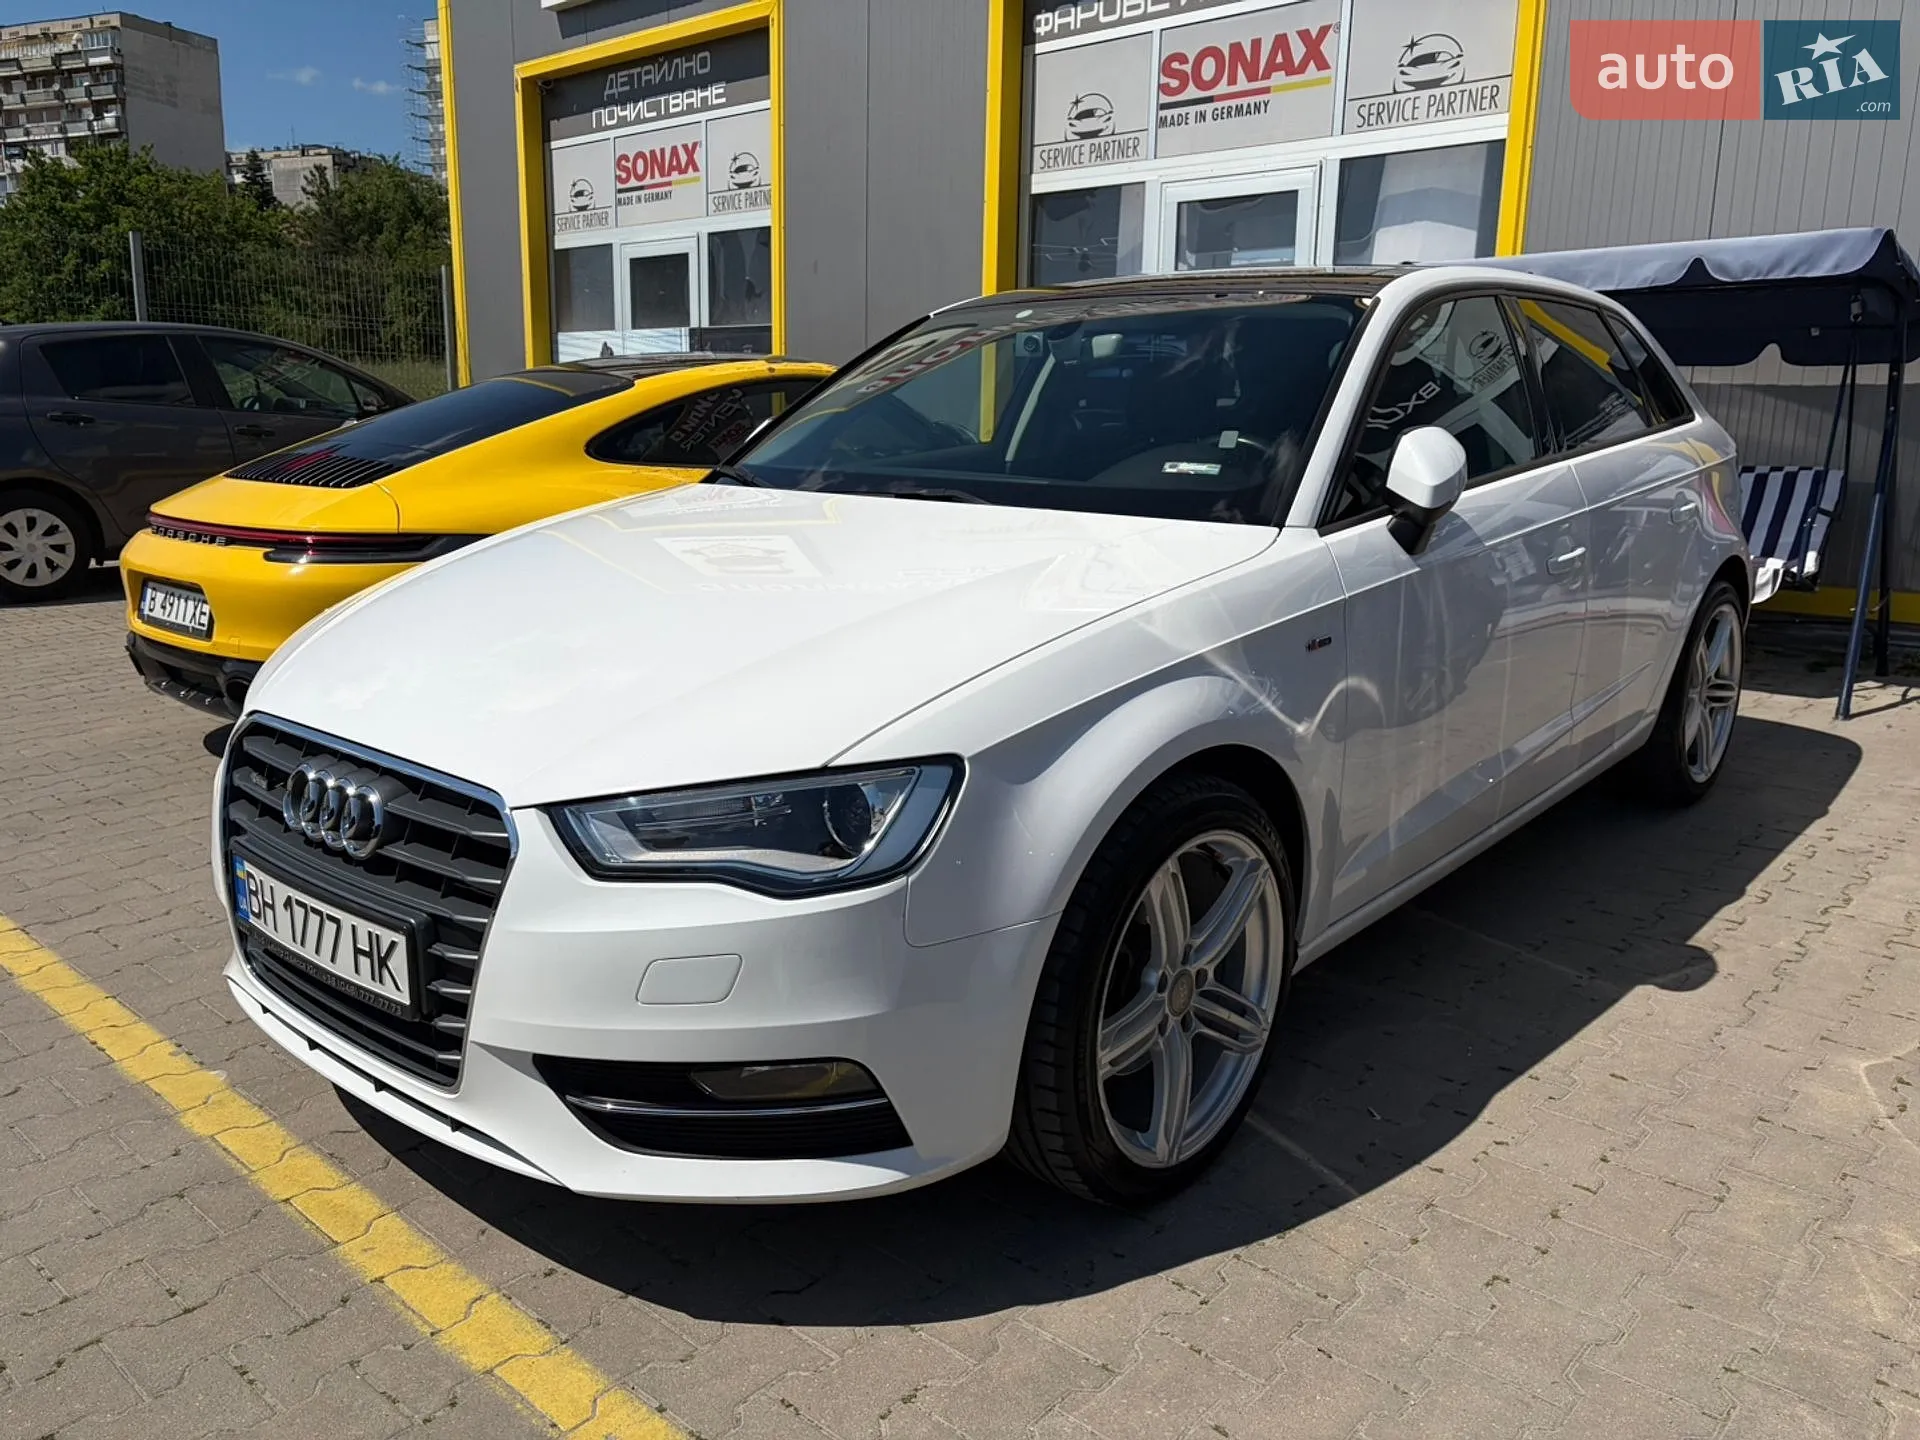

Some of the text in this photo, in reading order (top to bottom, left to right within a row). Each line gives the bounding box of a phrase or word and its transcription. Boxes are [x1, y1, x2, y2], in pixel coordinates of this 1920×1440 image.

[603, 51, 711, 101] ДЕТАЙЛНО
[1159, 23, 1333, 98] SONAX
[592, 81, 727, 129] ПОЧИСТВАНЕ
[1158, 99, 1271, 129] MADE IN GERMANY
[1357, 84, 1500, 129] SERVICE PARTNER
[615, 141, 700, 186] SONAX
[1039, 136, 1140, 170] SERVICE PARTNER
[617, 189, 673, 207] MADE IN GERMANY
[712, 193, 742, 213] SERVICE
[557, 210, 609, 233] SERVICE PARTNER
[151, 525, 227, 546] PORSCHE
[246, 869, 278, 934] BH
[282, 894, 342, 965] 1777
[351, 922, 404, 993] HK
